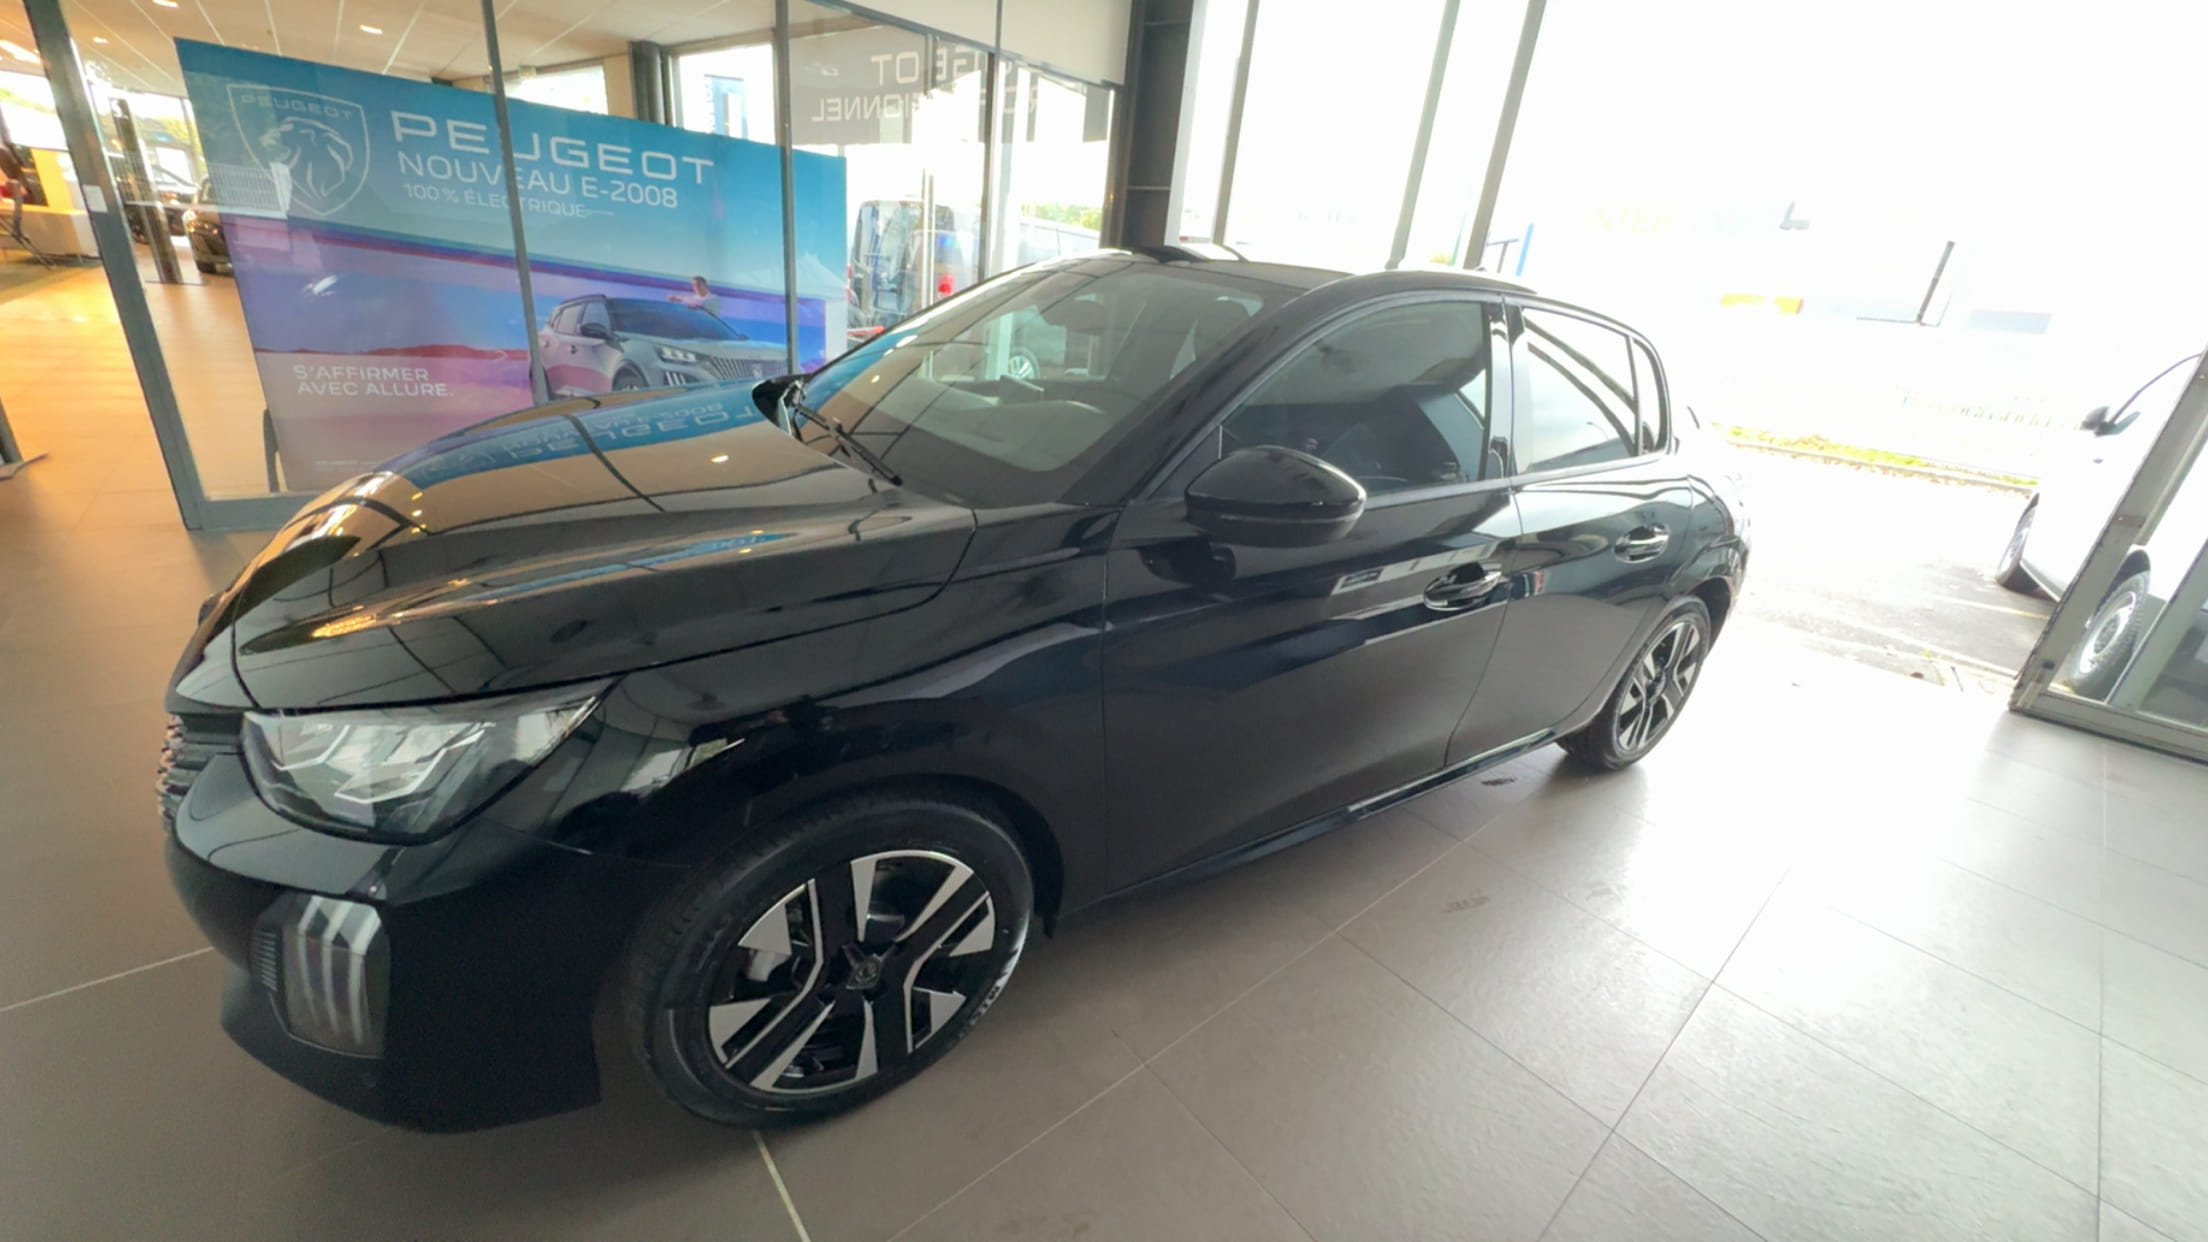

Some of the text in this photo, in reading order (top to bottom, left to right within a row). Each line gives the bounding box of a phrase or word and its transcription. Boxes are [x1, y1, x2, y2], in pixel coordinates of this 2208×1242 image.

[240, 94, 353, 120] PEUGEOT
[390, 110, 715, 185] PEUGEOT
[397, 151, 678, 208] NOUVEAU E-2008
[464, 189, 587, 218] ÉLECTRIQUE
[292, 364, 429, 382] S'AFFIRMER
[297, 381, 455, 398] AVEC ALLURE.
